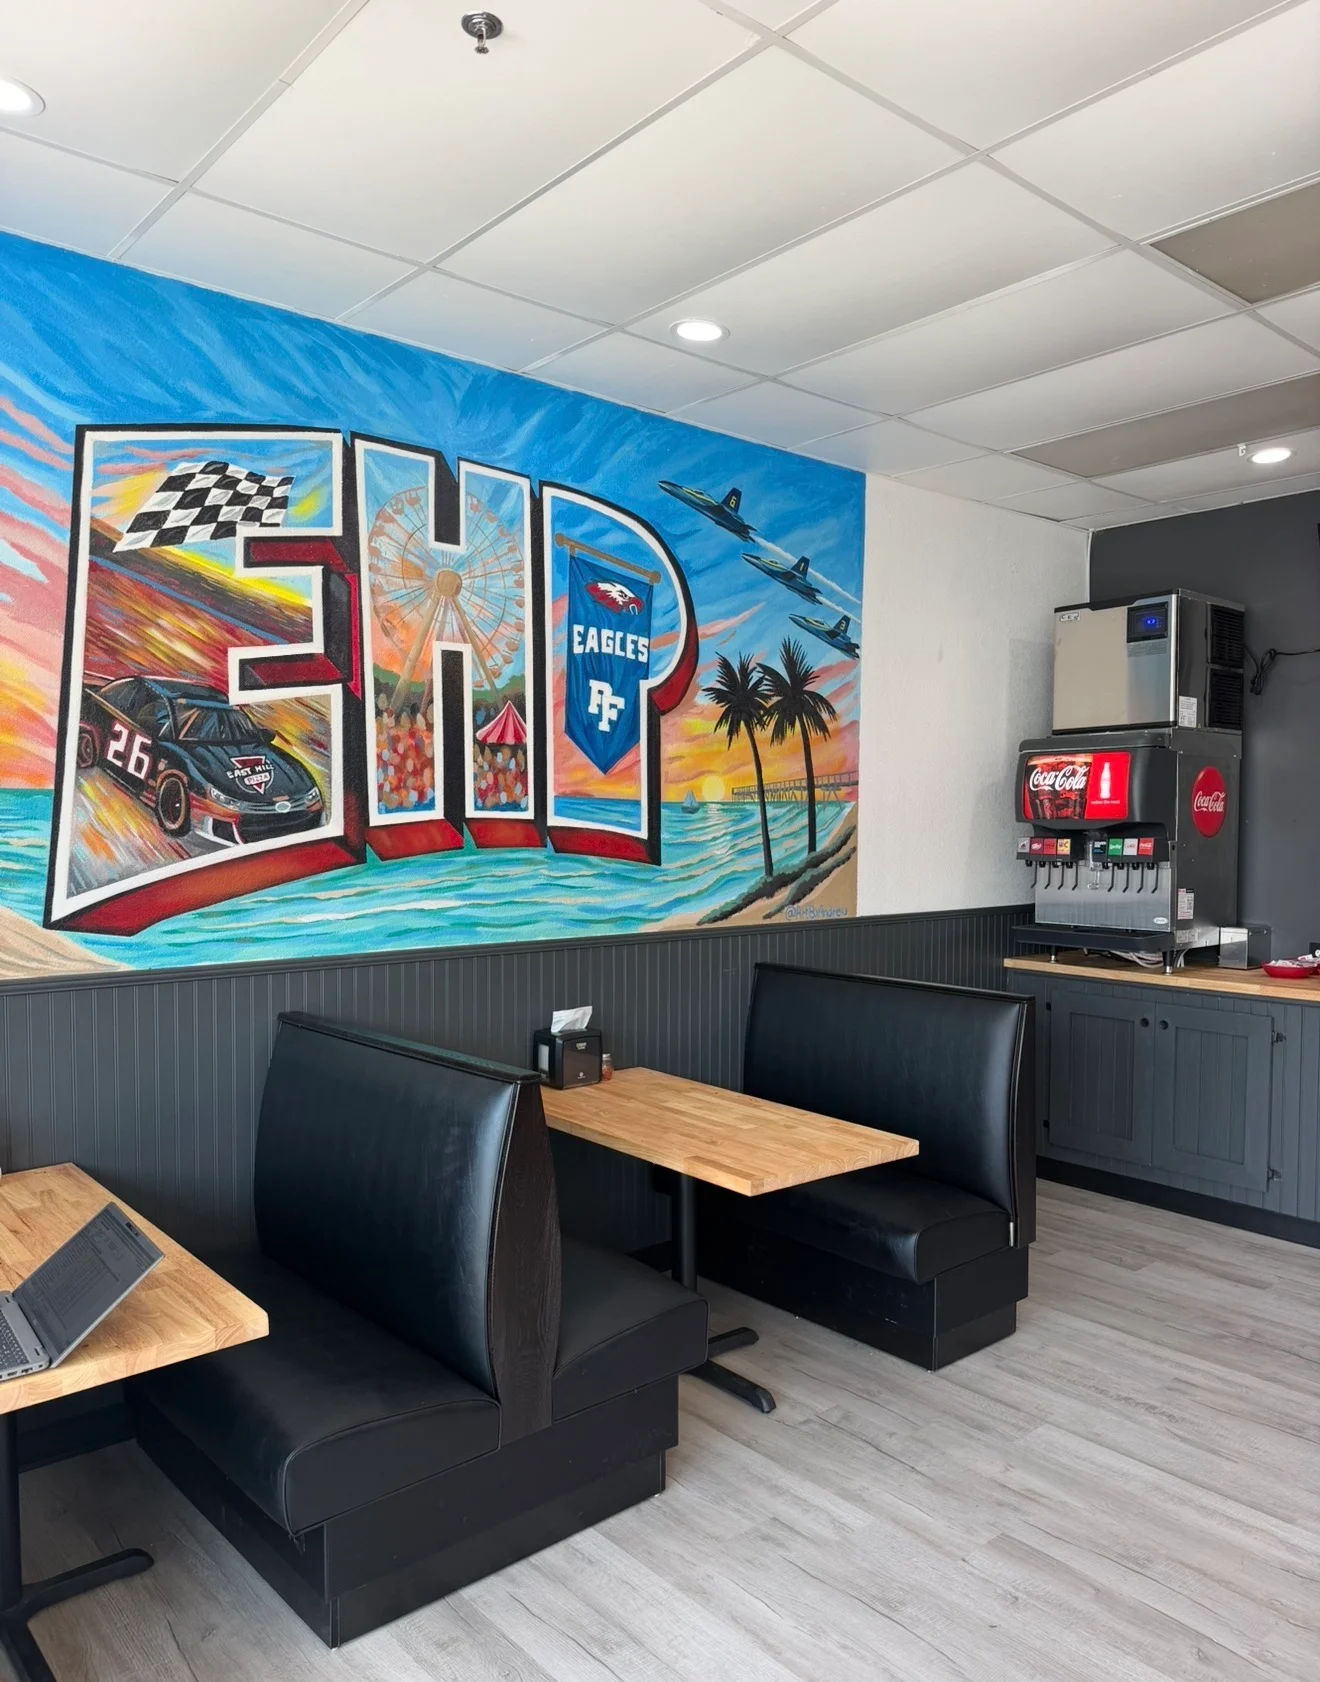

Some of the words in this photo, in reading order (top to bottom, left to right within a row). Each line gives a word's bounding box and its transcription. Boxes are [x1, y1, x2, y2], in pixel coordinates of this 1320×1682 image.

[729, 497, 737, 509] 6
[798, 562, 806, 572] 1
[839, 619, 846, 630] 3
[573, 624, 649, 663] EAGLES
[45, 425, 698, 937] EHP
[588, 680, 625, 732] PF
[106, 722, 152, 780] 26
[226, 768, 252, 779] EAST
[254, 764, 275, 773] HILL
[246, 774, 269, 784] PIZZA
[1029, 765, 1090, 791] Coca-Cola
[1193, 791, 1226, 812] Coca-Cola
